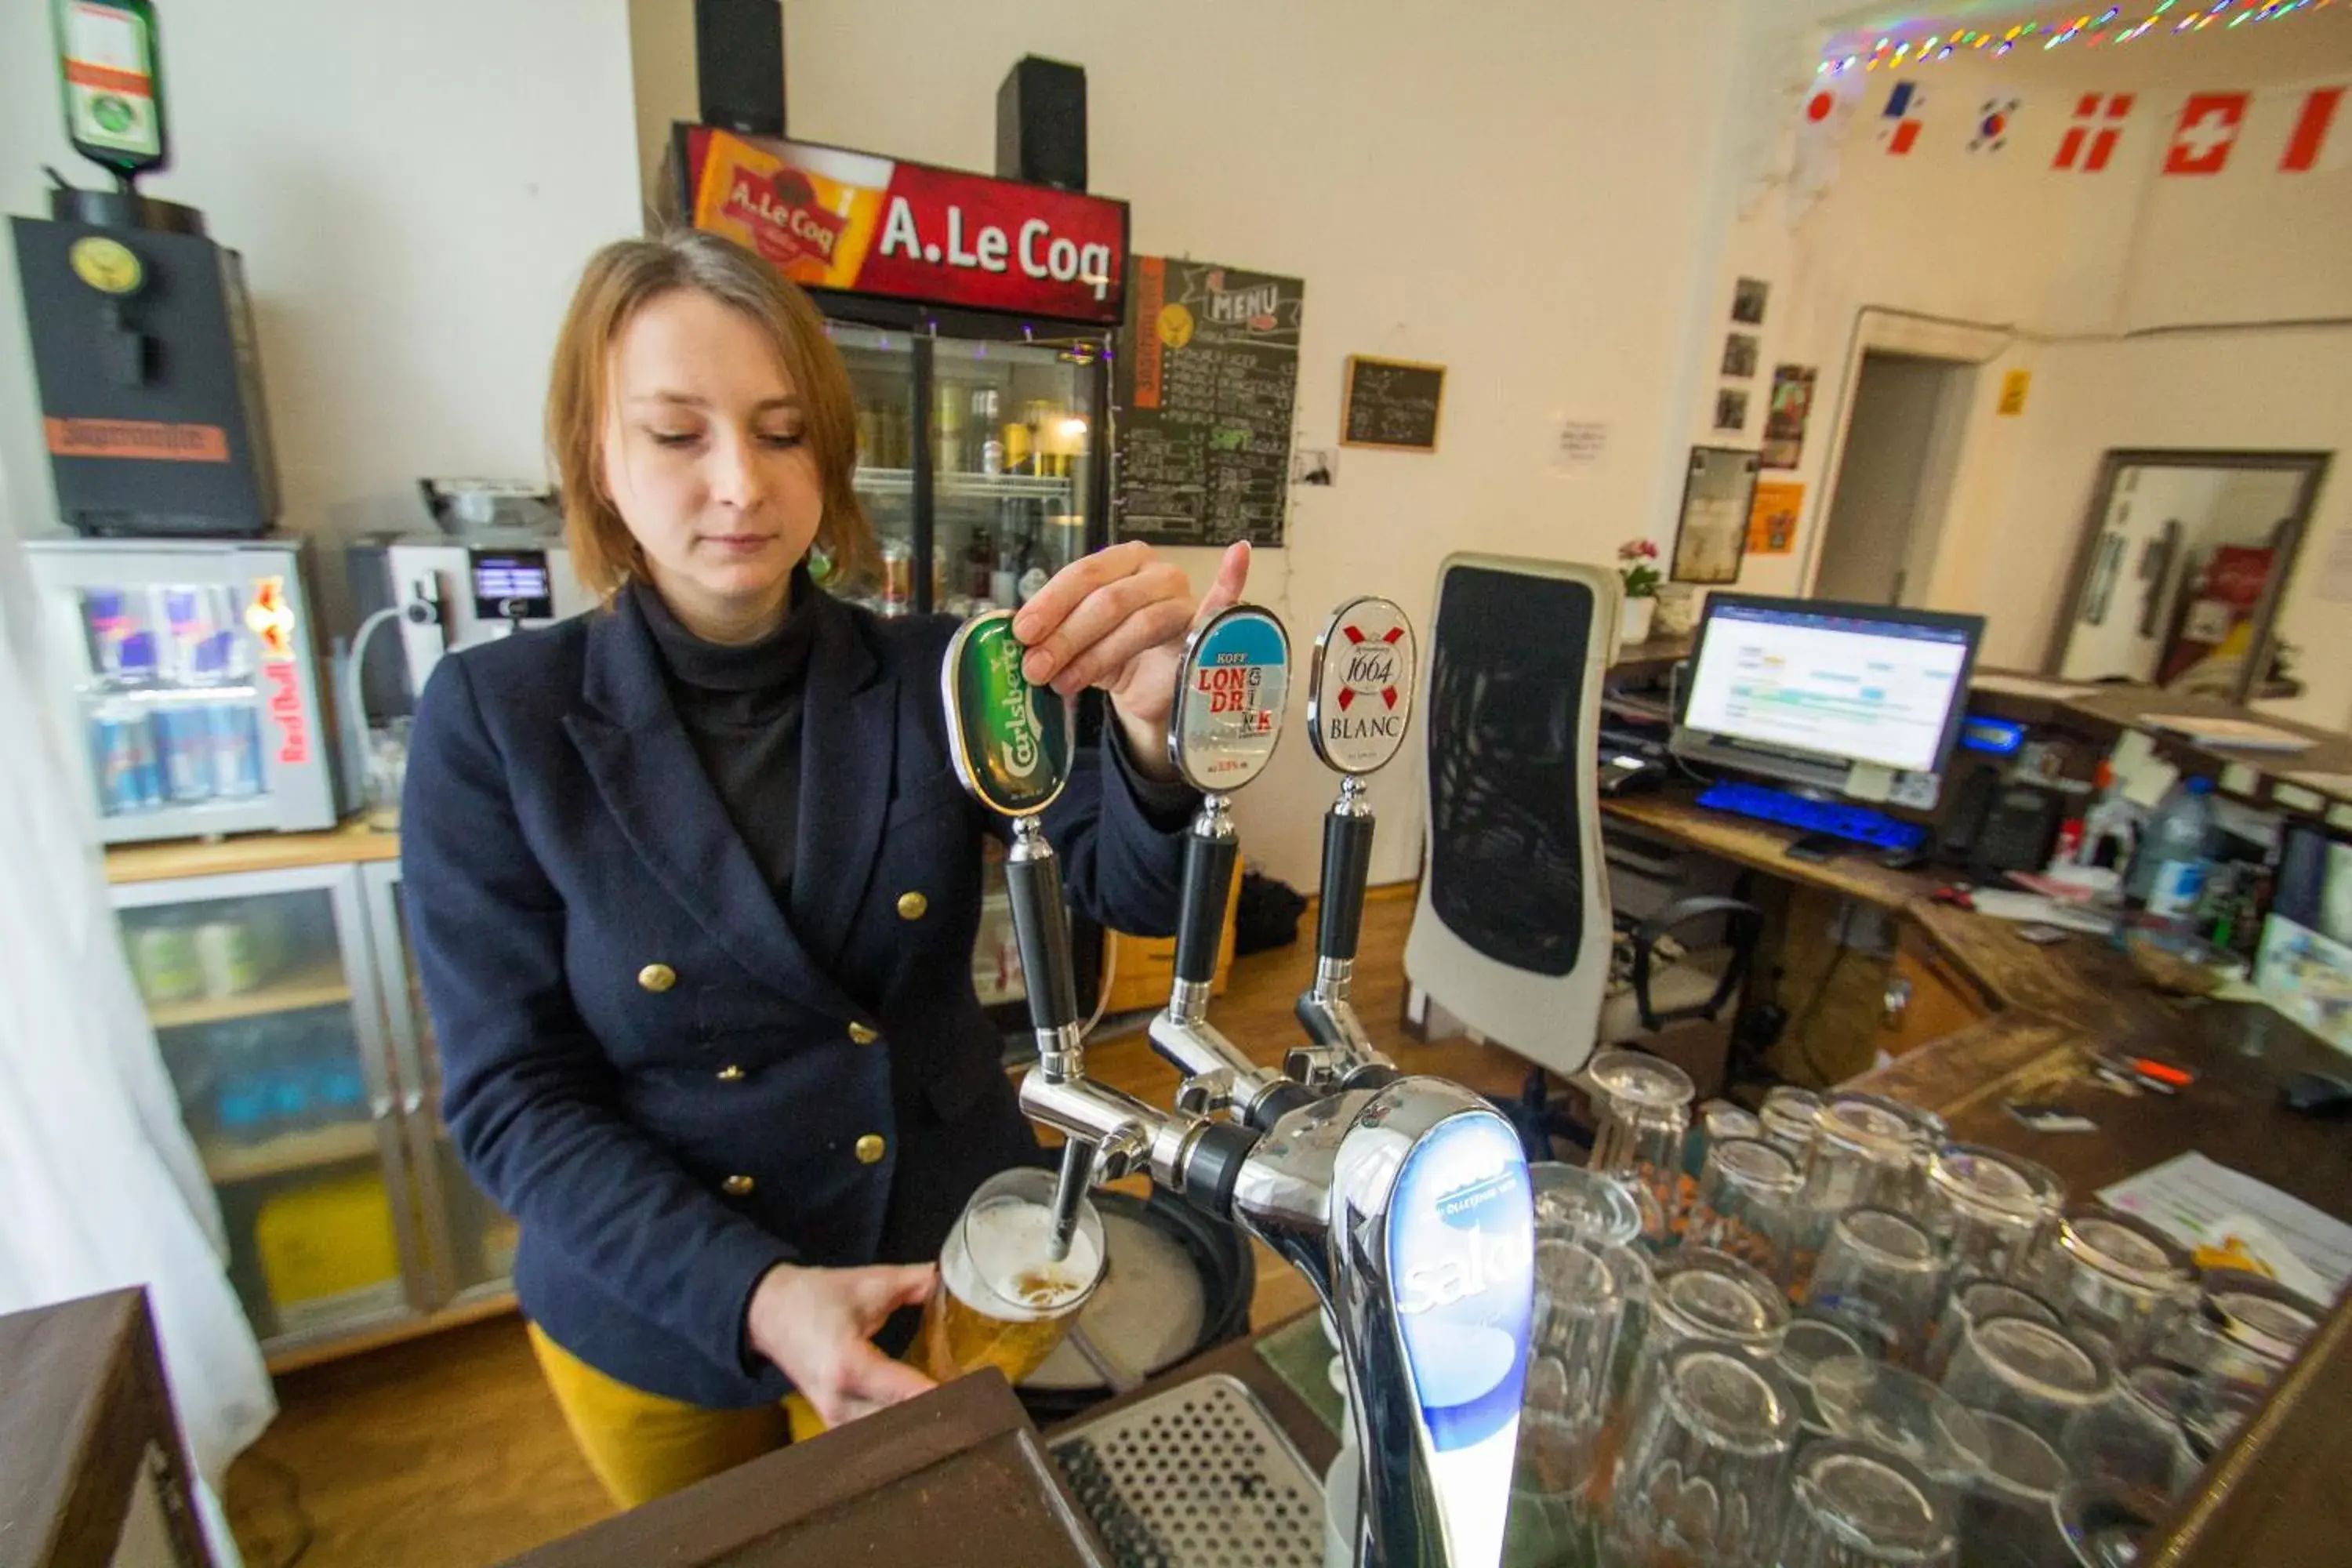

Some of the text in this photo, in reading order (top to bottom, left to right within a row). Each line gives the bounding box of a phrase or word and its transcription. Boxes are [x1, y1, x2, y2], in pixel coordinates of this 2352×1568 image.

[789, 208, 834, 257] Coq
[1018, 220, 1110, 300] Coq
[1212, 285, 1279, 321] MENU
[1198, 668, 1262, 691] LONG
[1347, 652, 1394, 684] 1664
[1001, 638, 1040, 779] Carlsberg
[1330, 716, 1400, 739] BLANC
